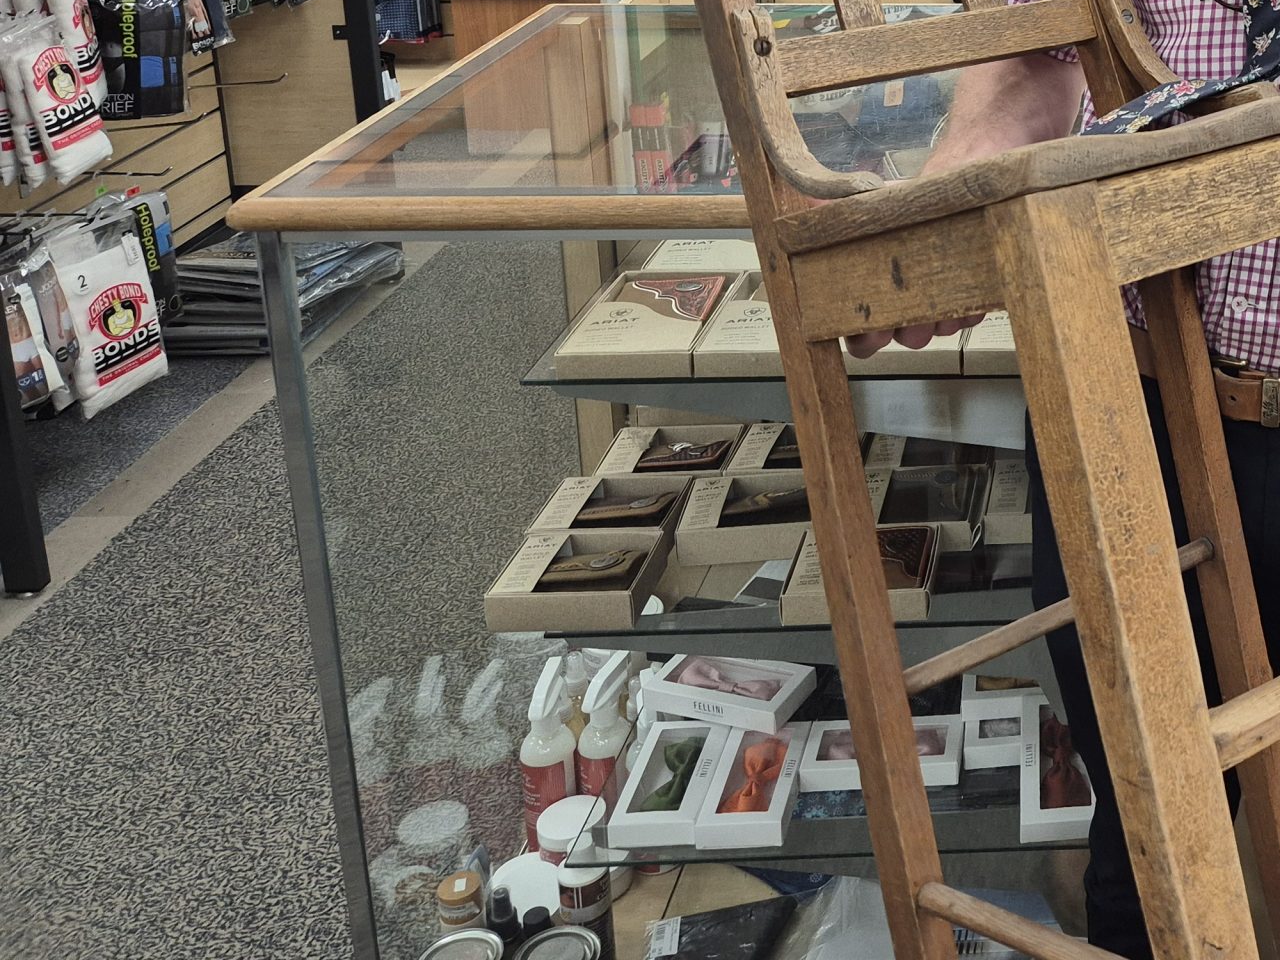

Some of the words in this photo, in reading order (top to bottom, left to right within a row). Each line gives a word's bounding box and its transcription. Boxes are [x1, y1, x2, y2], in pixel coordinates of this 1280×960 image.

[43, 93, 92, 125] BOND
[101, 101, 134, 113] RIEF
[137, 204, 160, 273] Holeproof
[91, 287, 118, 317] CHESTY
[119, 284, 141, 299] BOND
[589, 317, 642, 325] ARIAT
[93, 322, 161, 363] BONDS
[693, 701, 724, 715] FELLINI
[700, 758, 713, 778] FELLINI
[785, 759, 797, 778] FELLINI
